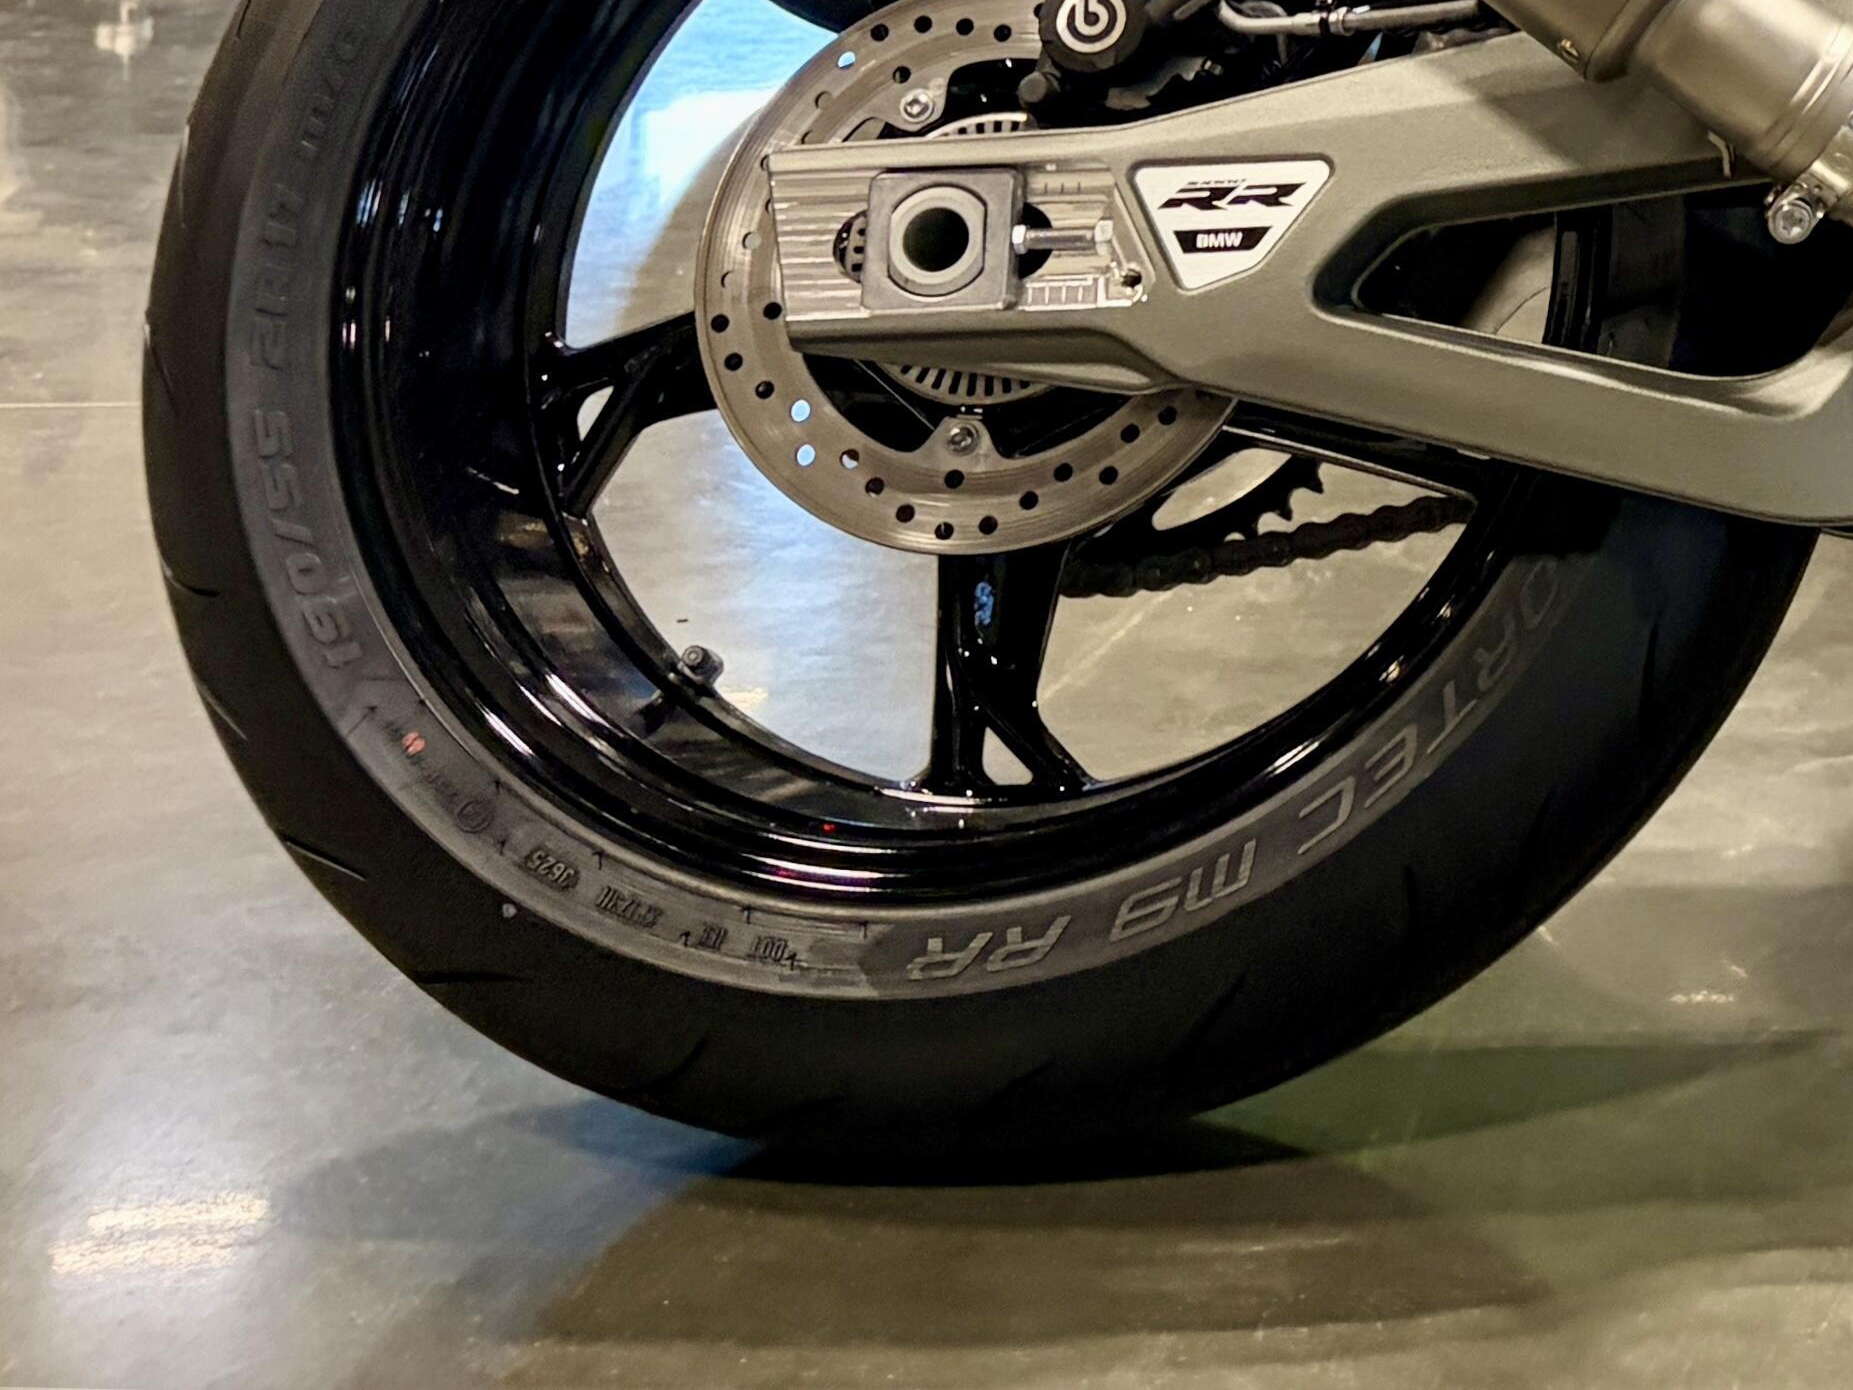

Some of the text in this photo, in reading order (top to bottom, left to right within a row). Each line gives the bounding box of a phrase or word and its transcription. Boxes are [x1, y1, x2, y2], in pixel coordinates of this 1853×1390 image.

[1157, 181, 1308, 211] RR
[1195, 231, 1244, 249] BMW
[1297, 559, 1558, 856] ORTEC
[906, 914, 1073, 981] RR
